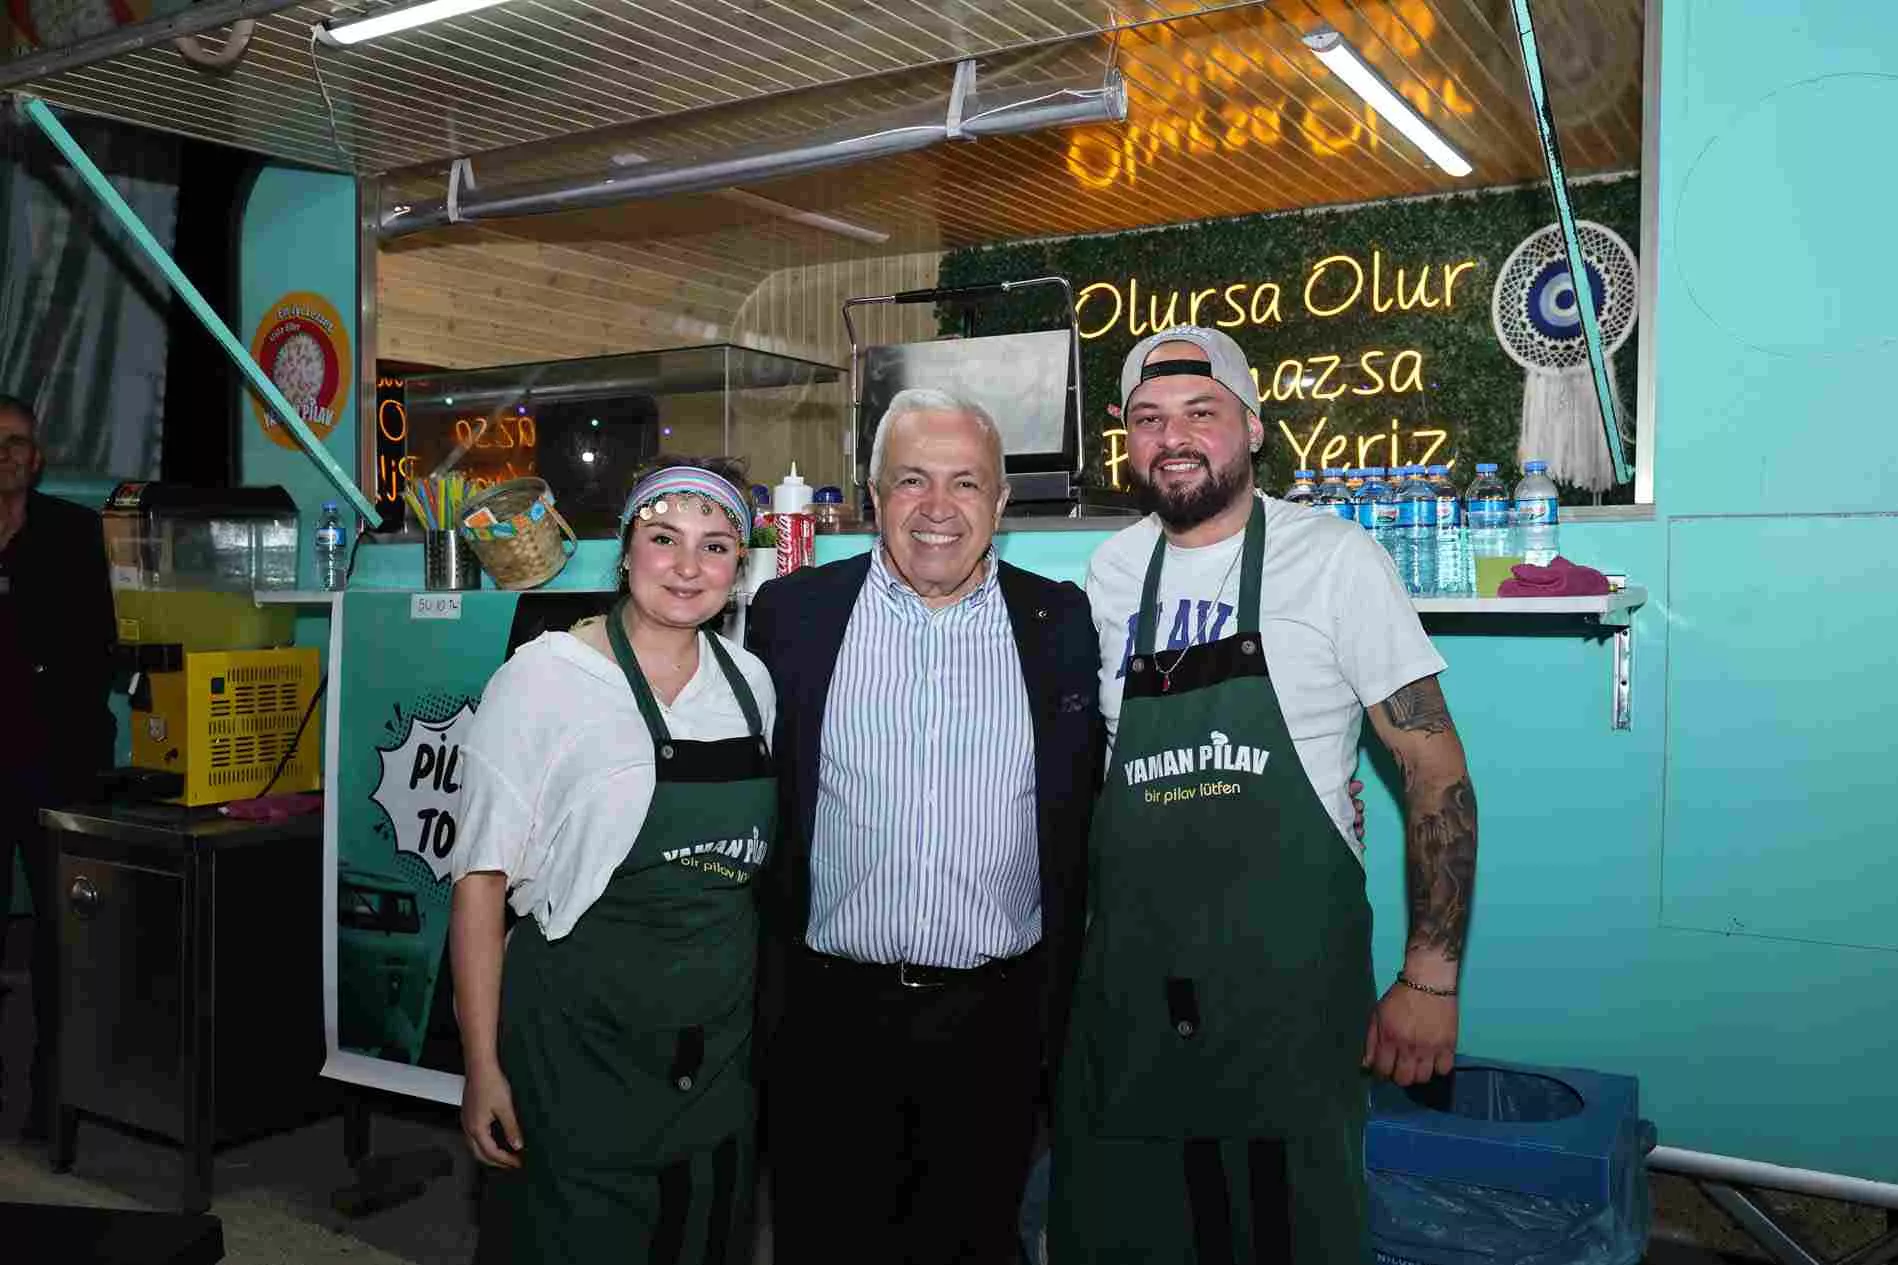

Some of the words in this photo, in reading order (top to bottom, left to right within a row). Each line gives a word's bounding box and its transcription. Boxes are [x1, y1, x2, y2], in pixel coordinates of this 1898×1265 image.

[1074, 279, 1281, 338] Olursa
[1304, 251, 1477, 316] Olur
[1250, 350, 1424, 402] azsa
[1279, 417, 1456, 470] Yeriz
[409, 733, 463, 793] PİL
[1124, 748, 1194, 786] YAMAN
[1199, 731, 1270, 775] PİLAV
[1144, 790, 1161, 803] bir
[1164, 787, 1196, 805] pilav
[1199, 781, 1241, 798] lütfen
